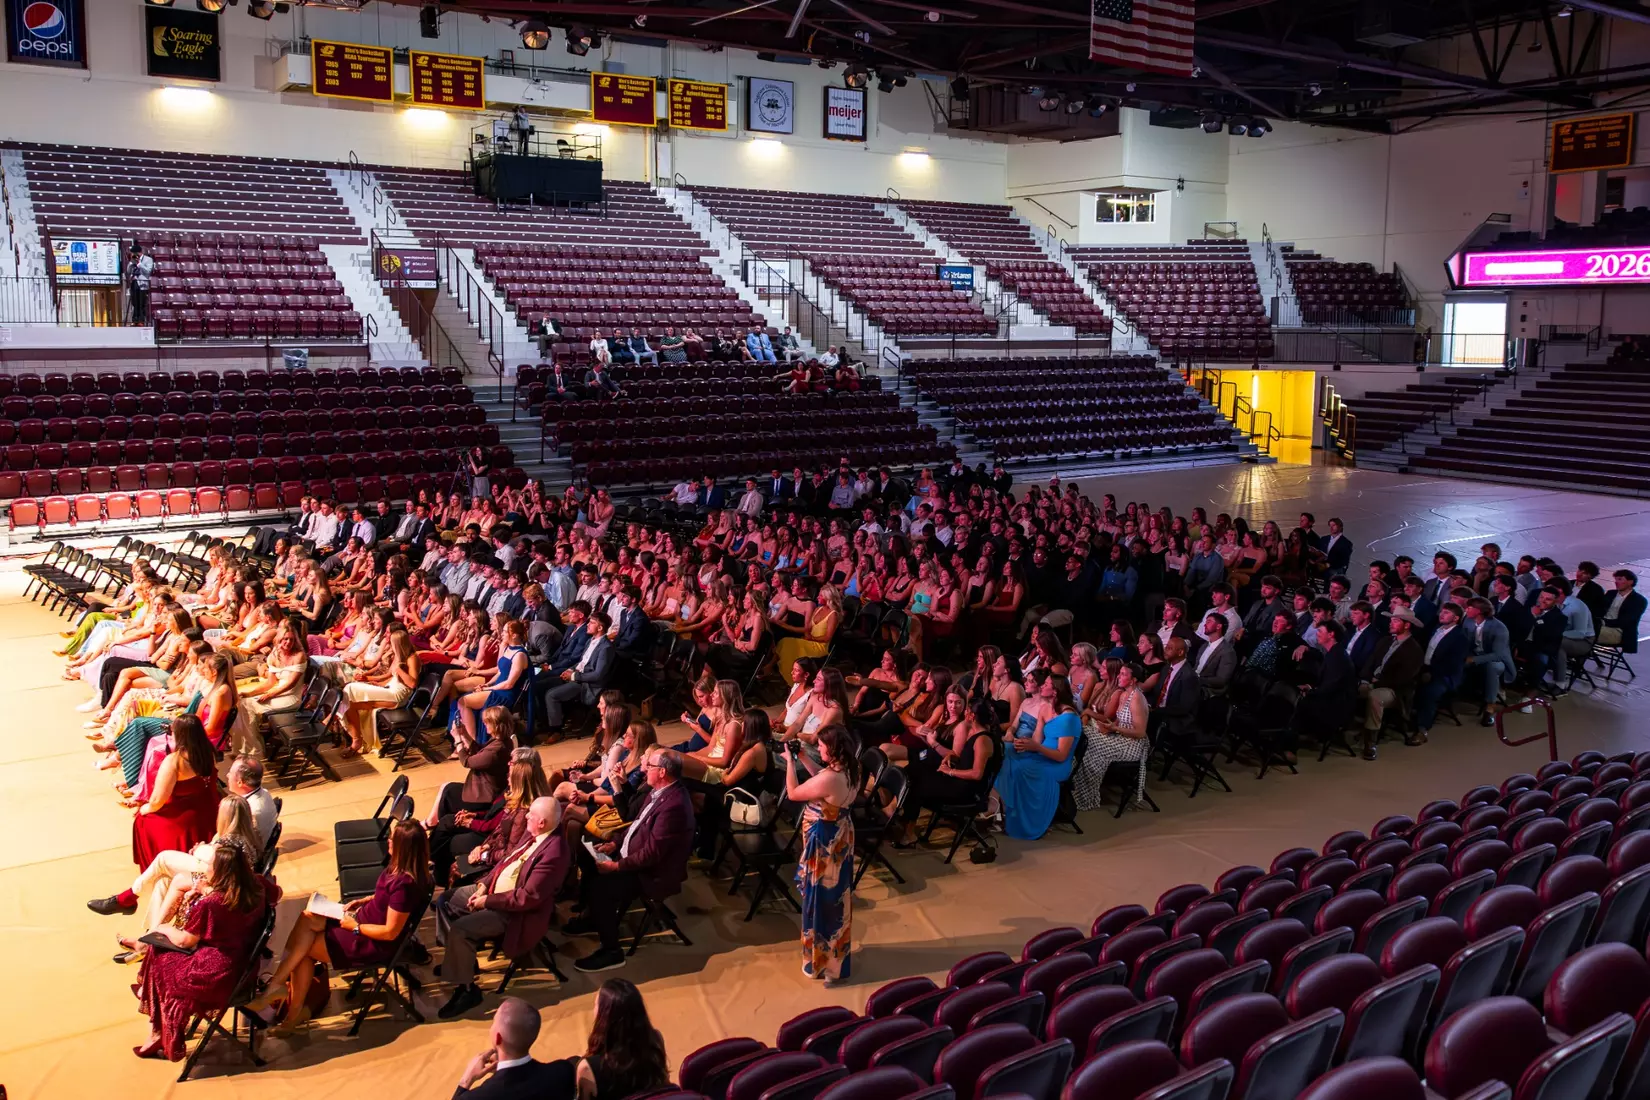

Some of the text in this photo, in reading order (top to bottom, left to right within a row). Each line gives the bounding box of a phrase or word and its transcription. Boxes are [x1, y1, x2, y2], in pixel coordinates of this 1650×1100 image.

[168, 28, 213, 44] Soaring
[20, 39, 72, 55] pepsi
[174, 41, 204, 55] Eagle
[358, 55, 386, 63] Tournament
[829, 105, 862, 120] meijer
[1586, 253, 1650, 277] 2026
